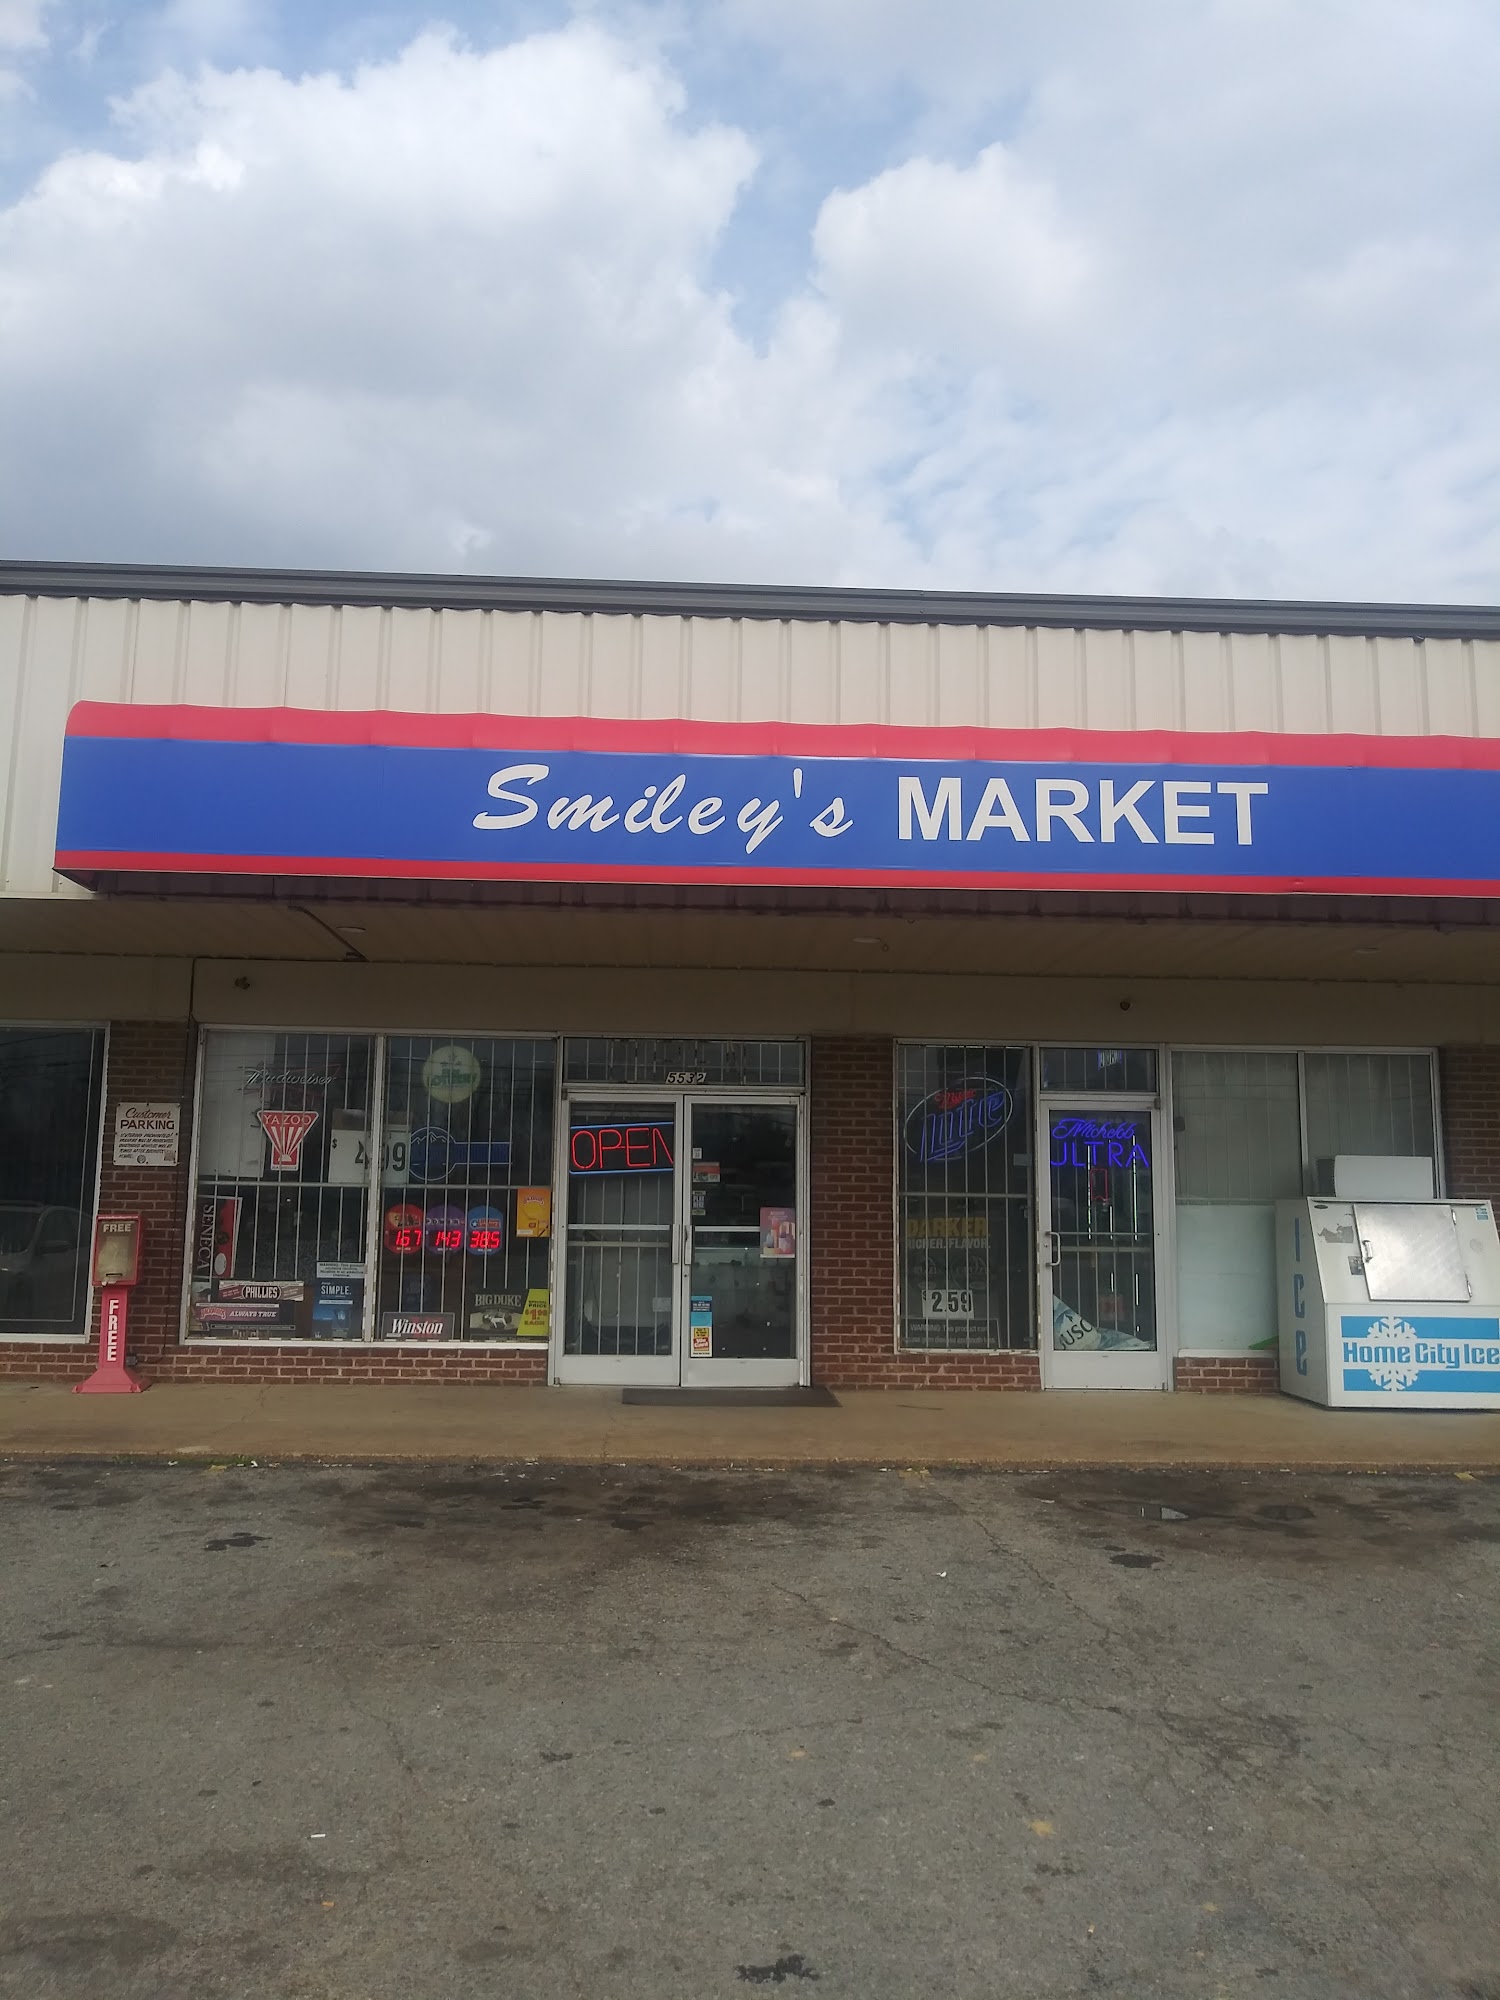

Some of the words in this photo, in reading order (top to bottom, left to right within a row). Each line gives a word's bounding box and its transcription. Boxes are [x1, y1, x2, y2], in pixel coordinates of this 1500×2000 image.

[472, 763, 853, 855] Smiley's
[897, 775, 1270, 847] MARKET
[245, 1068, 337, 1086] Budweiser
[666, 1072, 706, 1084] 5532
[125, 1107, 172, 1119] Customer
[263, 1114, 312, 1125] YAZOO
[120, 1119, 175, 1130] PARKING
[1051, 1117, 1138, 1140] Michelob
[571, 1126, 674, 1169] OPEN
[103, 1223, 132, 1233] FREE
[196, 1204, 215, 1271] SENECA
[395, 1230, 423, 1247] 167
[435, 1230, 463, 1248] 143
[245, 1286, 278, 1299] PHILLIES
[320, 1285, 352, 1295] SIMPLE.
[474, 1293, 496, 1307] BIG
[495, 1293, 522, 1308] DUKE
[922, 1290, 972, 1313] $2.59
[229, 1310, 257, 1318] ALWAYS
[106, 1299, 119, 1362] FREE
[391, 1318, 444, 1335] Winston
[1342, 1341, 1411, 1364] Home
[1414, 1342, 1461, 1369] City
[1464, 1343, 1500, 1365] Ice
